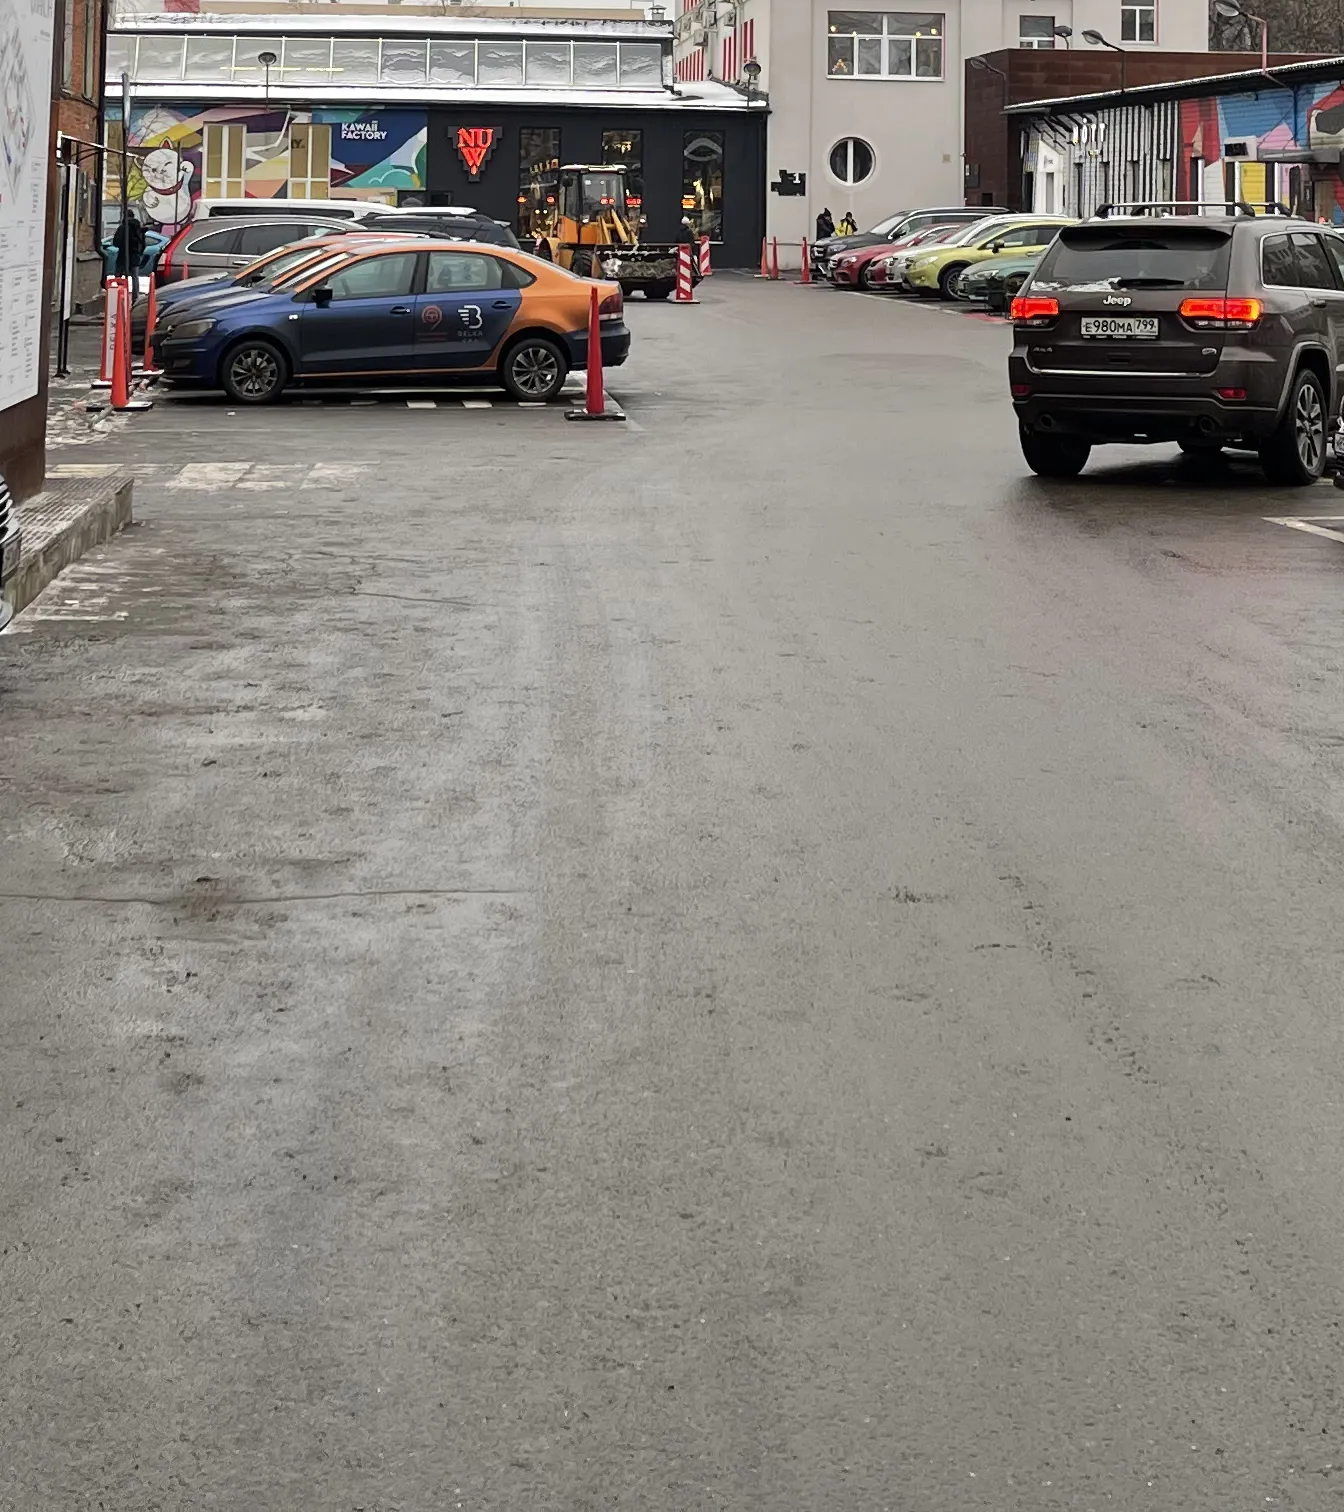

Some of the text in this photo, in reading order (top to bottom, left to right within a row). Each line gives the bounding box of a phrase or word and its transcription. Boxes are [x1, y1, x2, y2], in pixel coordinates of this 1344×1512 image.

[341, 131, 387, 140] FACTORY
[1103, 295, 1132, 307] Jeep
[1135, 319, 1155, 330] 799
